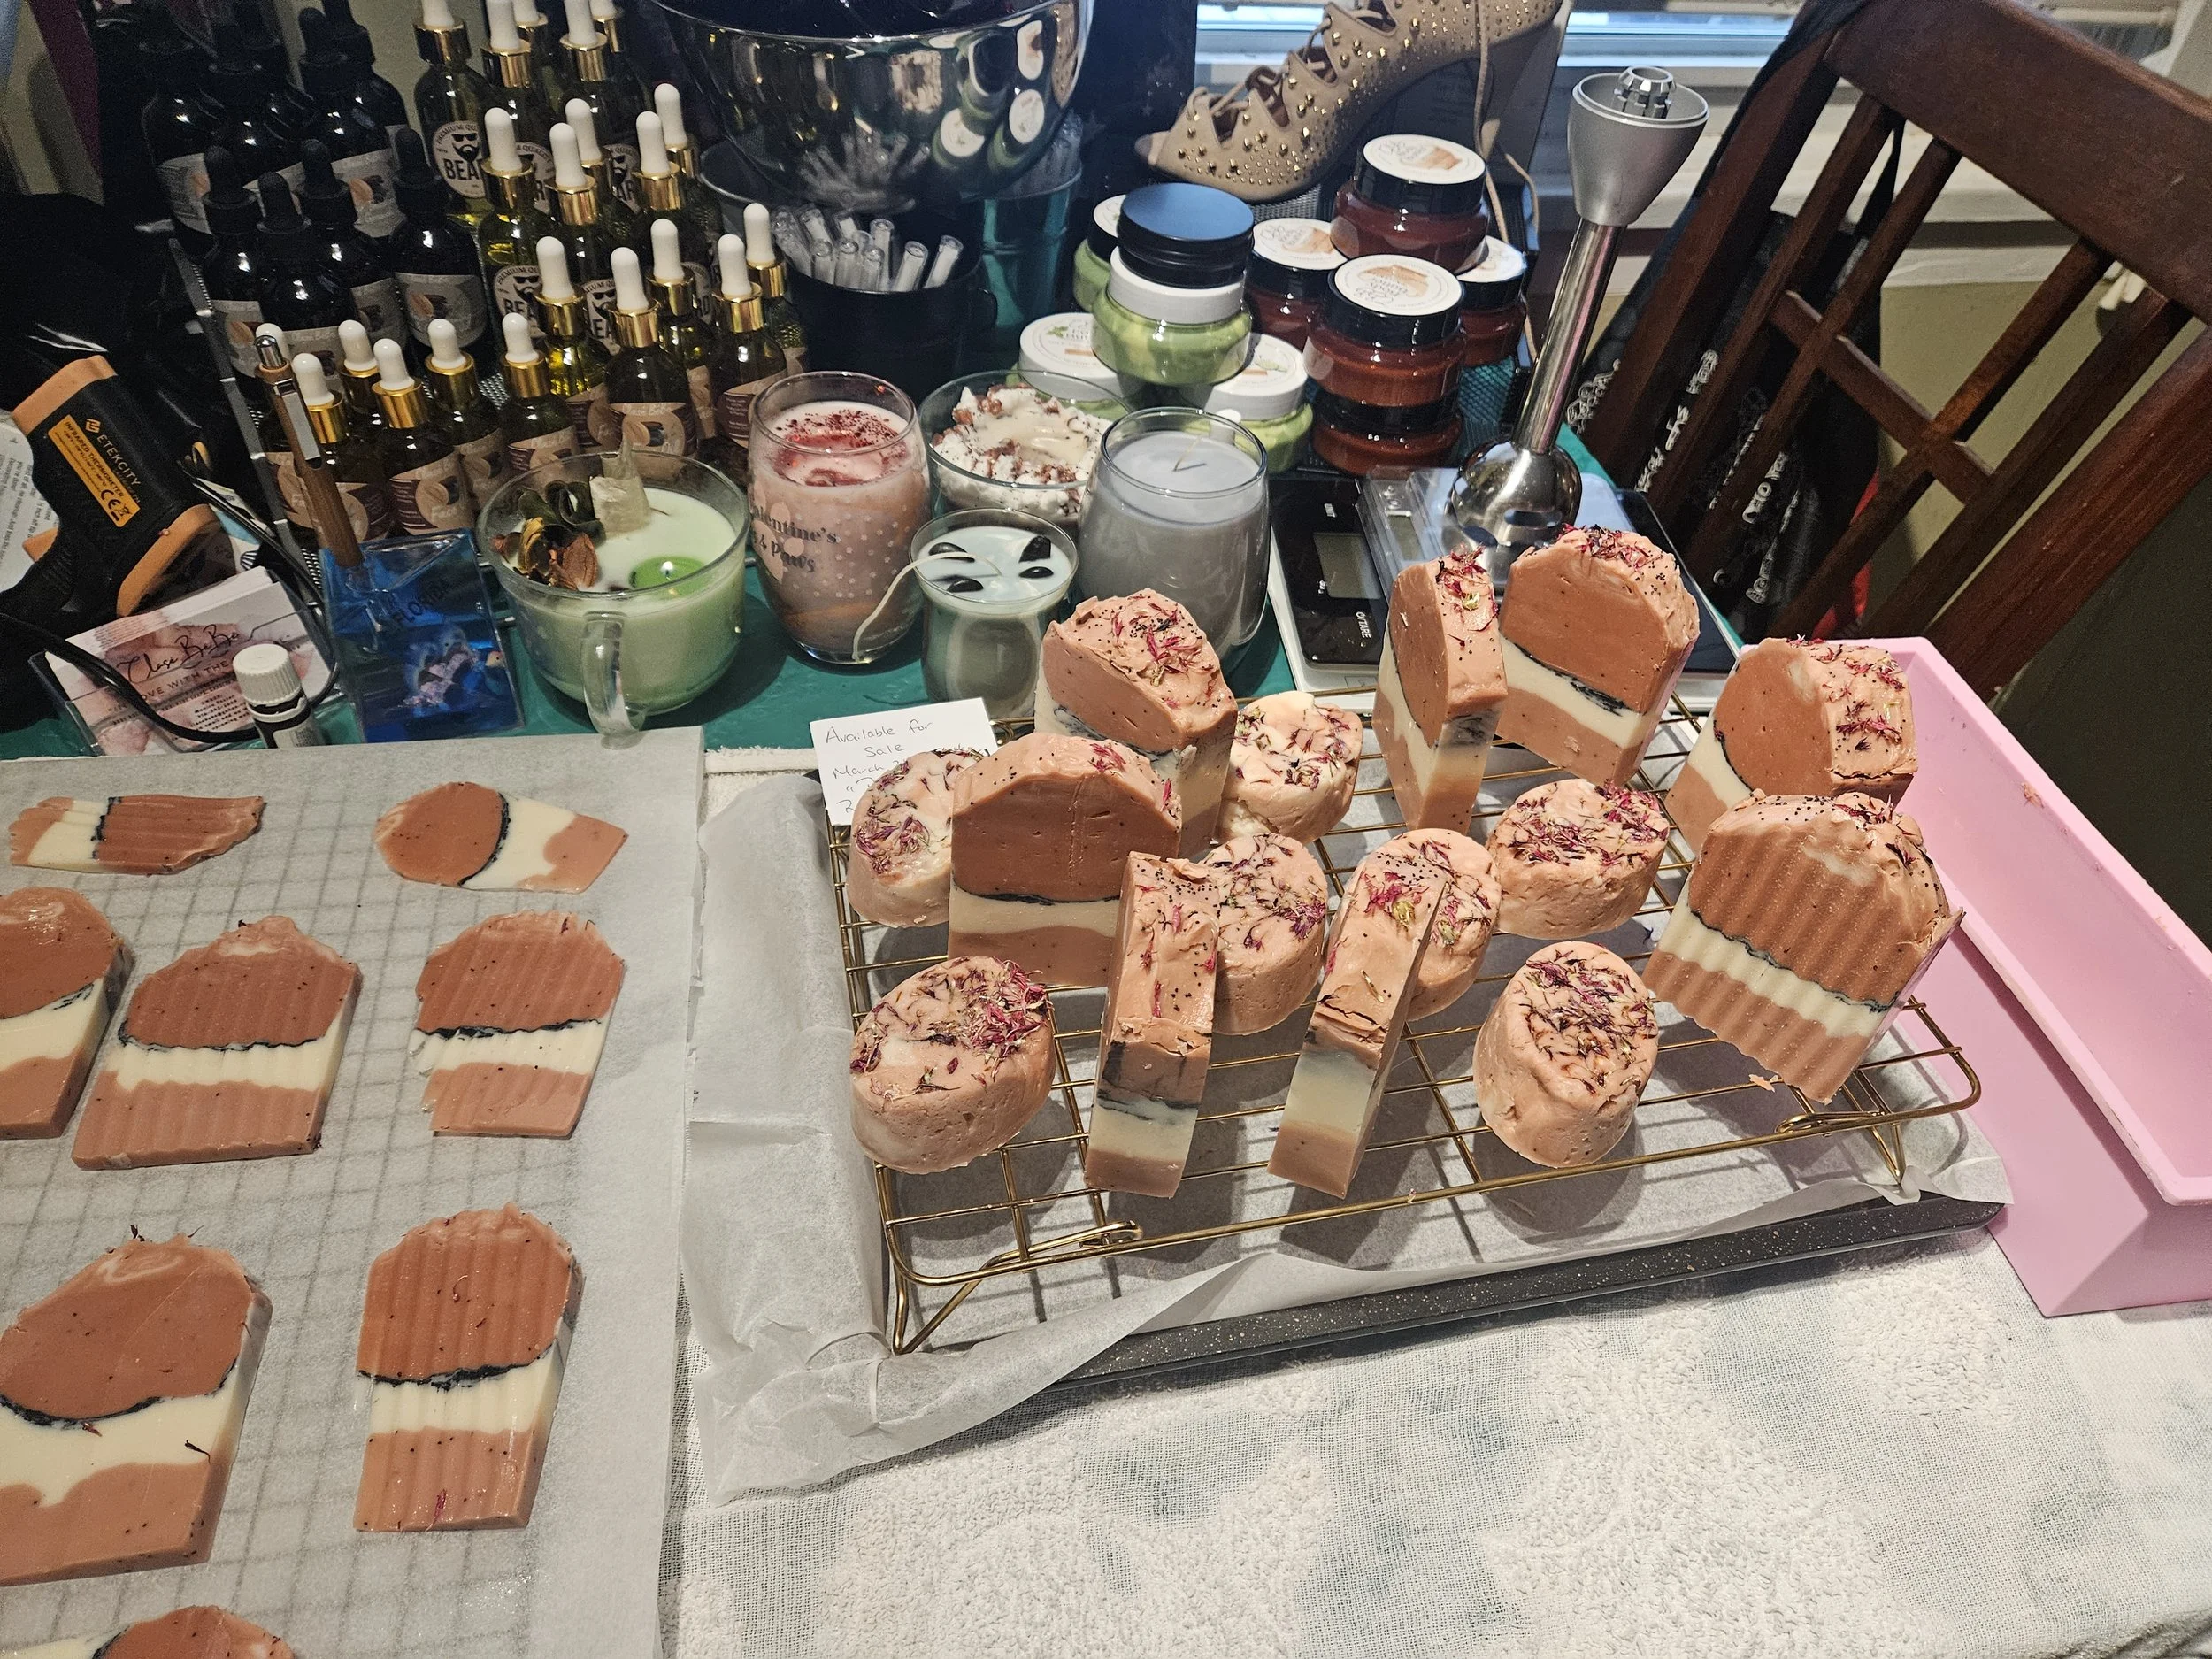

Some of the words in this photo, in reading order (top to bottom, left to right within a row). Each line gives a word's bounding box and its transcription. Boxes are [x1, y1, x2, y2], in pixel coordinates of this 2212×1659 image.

[443, 158, 480, 180] BEA
[65, 421, 90, 453] INFRARED
[88, 452, 125, 497] THERMOMETER
[97, 434, 142, 487] ETEKCITY
[751, 504, 838, 543] alentine's
[142, 687, 165, 702] OVE
[167, 672, 201, 689] WITH
[204, 660, 229, 673] THE
[826, 726, 896, 744] Available
[908, 718, 933, 733] for
[864, 743, 907, 758] Sale
[832, 764, 884, 780] March
